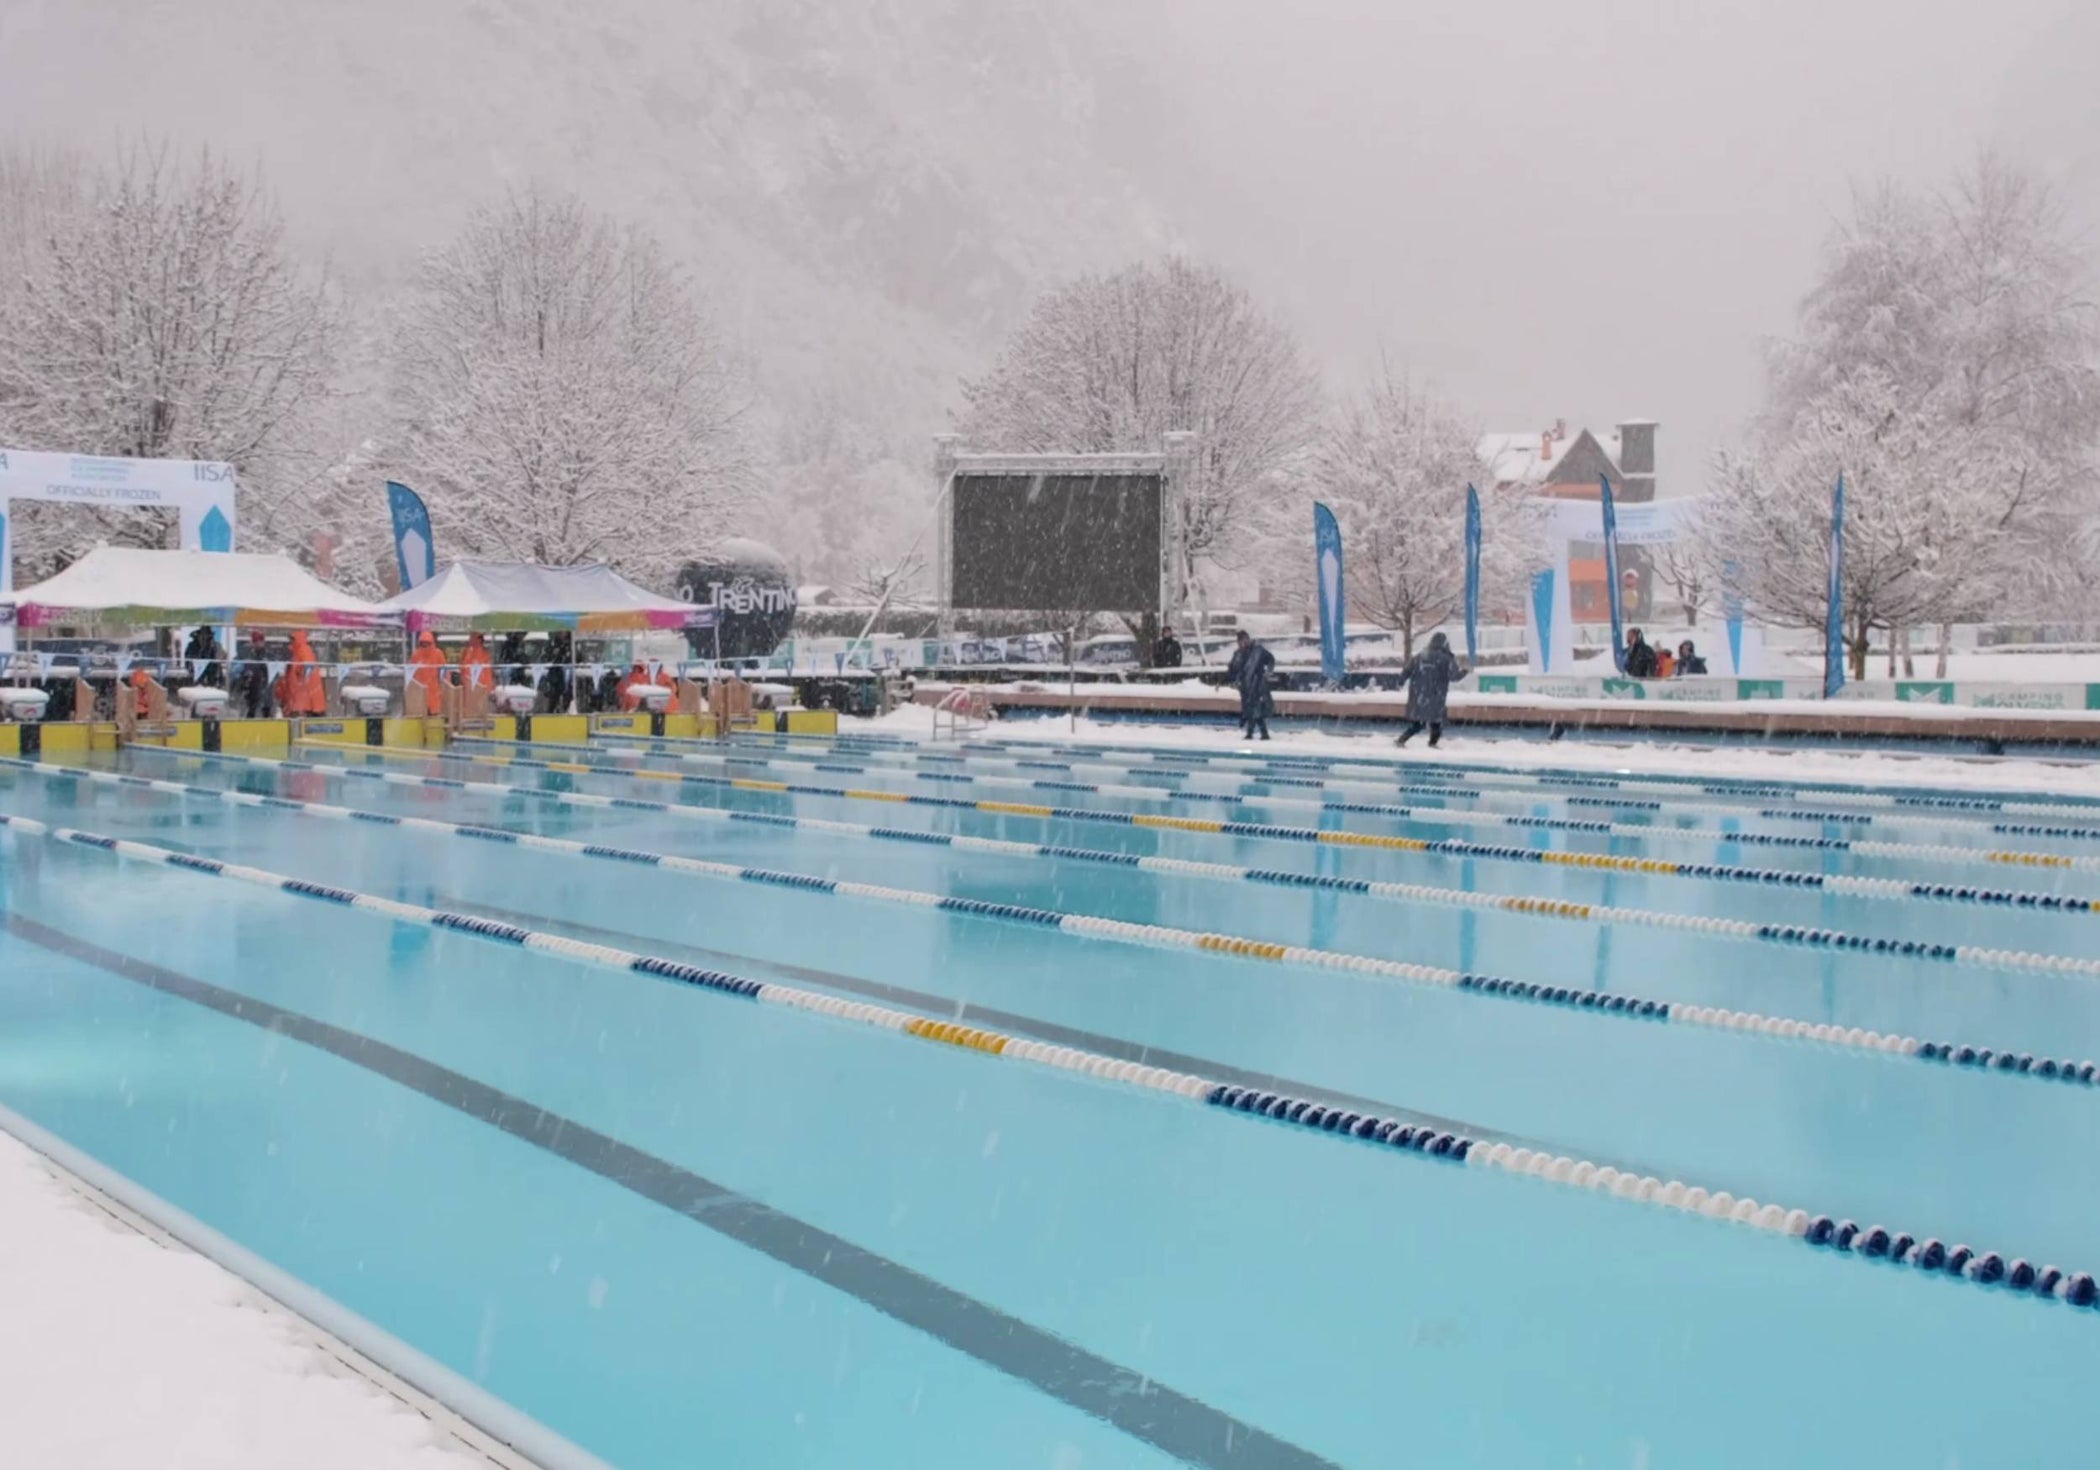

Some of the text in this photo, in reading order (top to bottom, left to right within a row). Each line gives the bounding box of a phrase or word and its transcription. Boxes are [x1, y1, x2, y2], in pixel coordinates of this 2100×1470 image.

[193, 463, 234, 482] IISA
[46, 484, 161, 500] OFFICIALLY FROZEN
